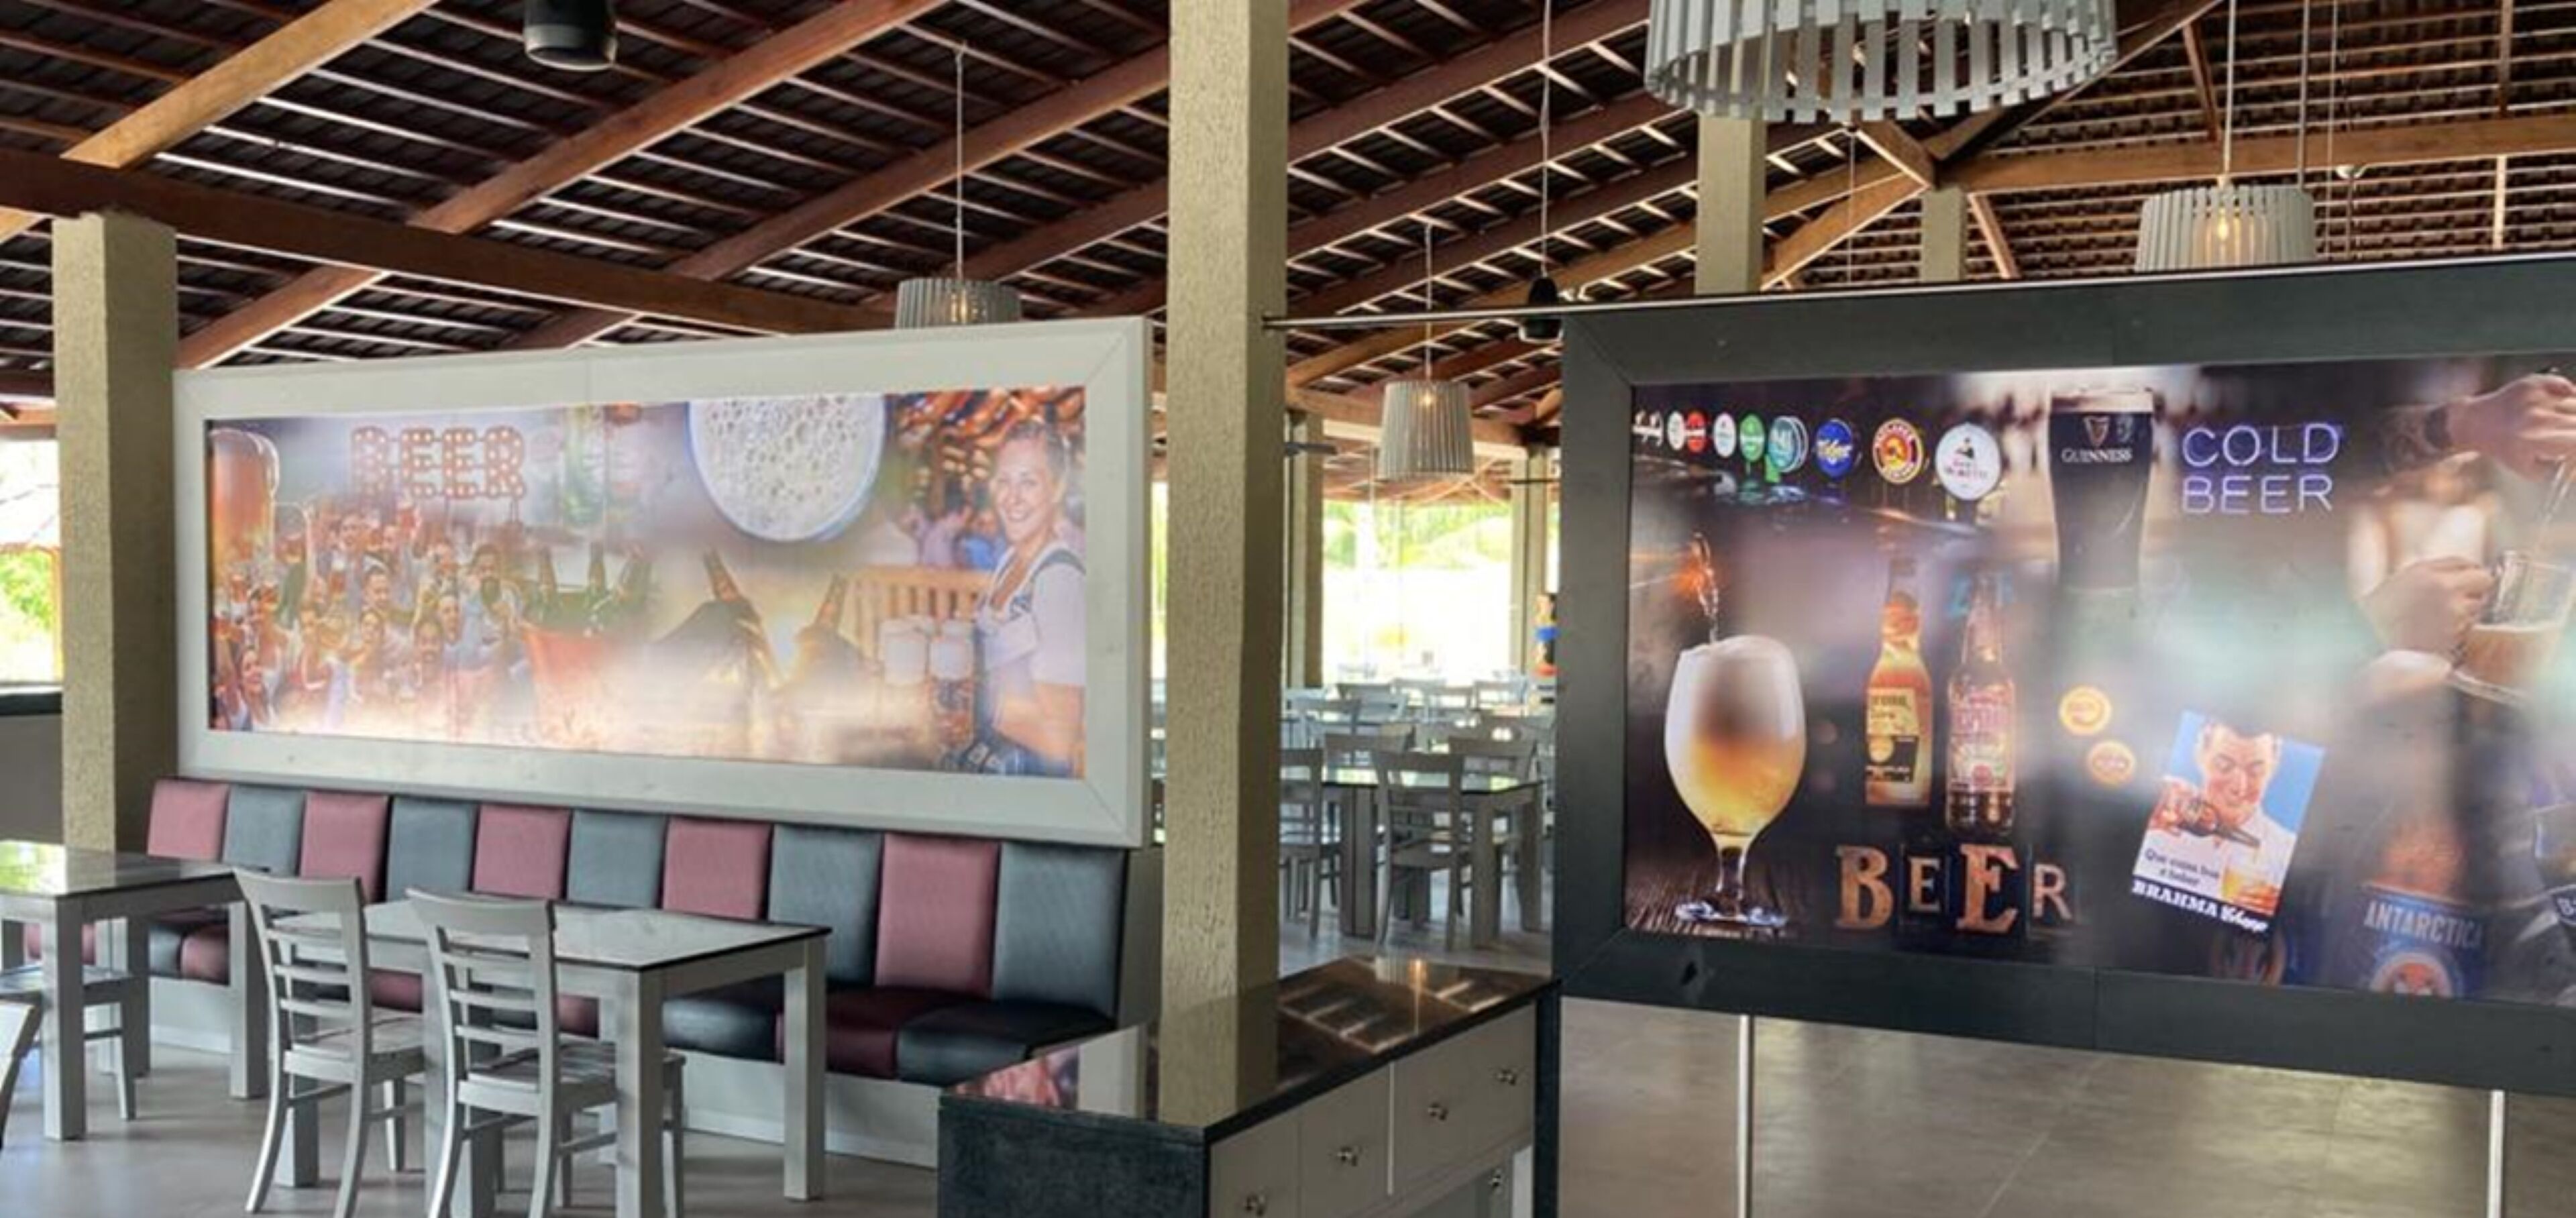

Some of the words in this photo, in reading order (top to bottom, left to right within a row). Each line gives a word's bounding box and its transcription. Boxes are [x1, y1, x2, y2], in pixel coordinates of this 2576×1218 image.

[351, 425, 525, 500] BEER
[2061, 447, 2133, 463] GUINNESS
[2182, 423, 2340, 467] COLD
[2182, 474, 2332, 514] BEER
[2132, 879, 2218, 918] BRAHMA
[2363, 900, 2482, 948] ANTARCTICA
